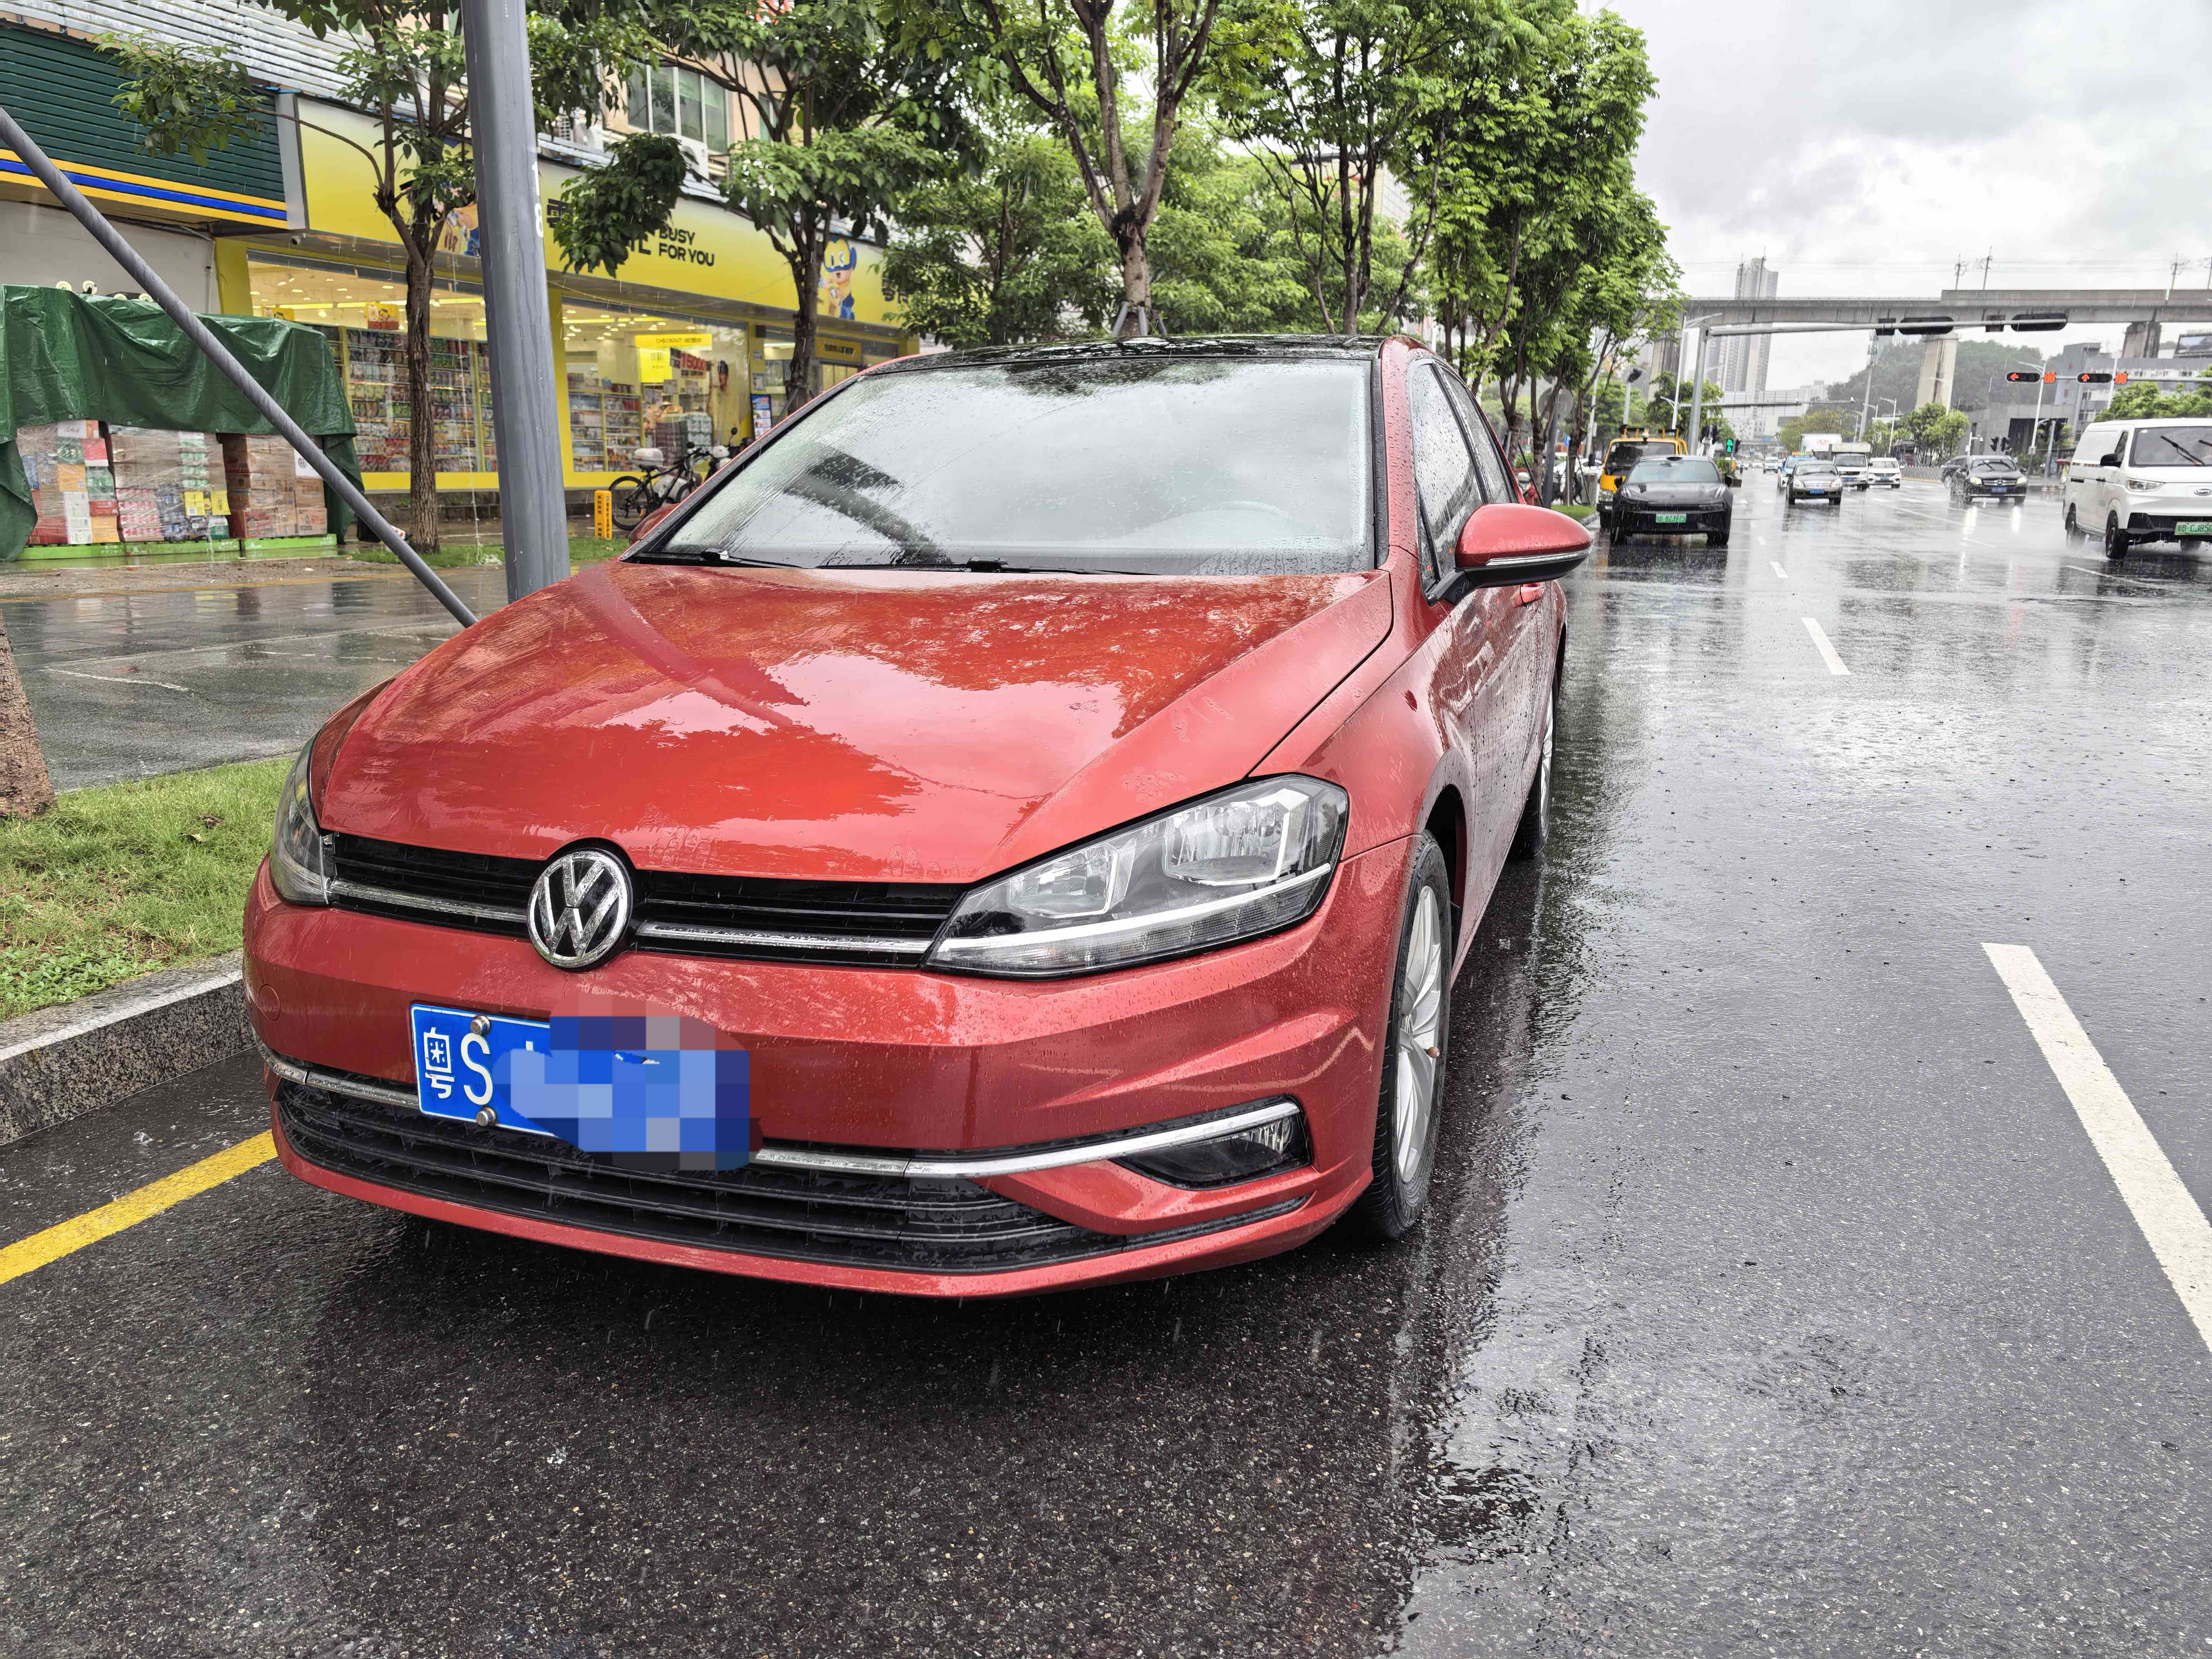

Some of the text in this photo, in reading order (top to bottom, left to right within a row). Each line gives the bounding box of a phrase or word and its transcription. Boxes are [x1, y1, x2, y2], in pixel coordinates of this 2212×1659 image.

[659, 227, 695, 245] BUSY
[659, 242, 686, 262] FOR
[687, 248, 715, 267] YOU
